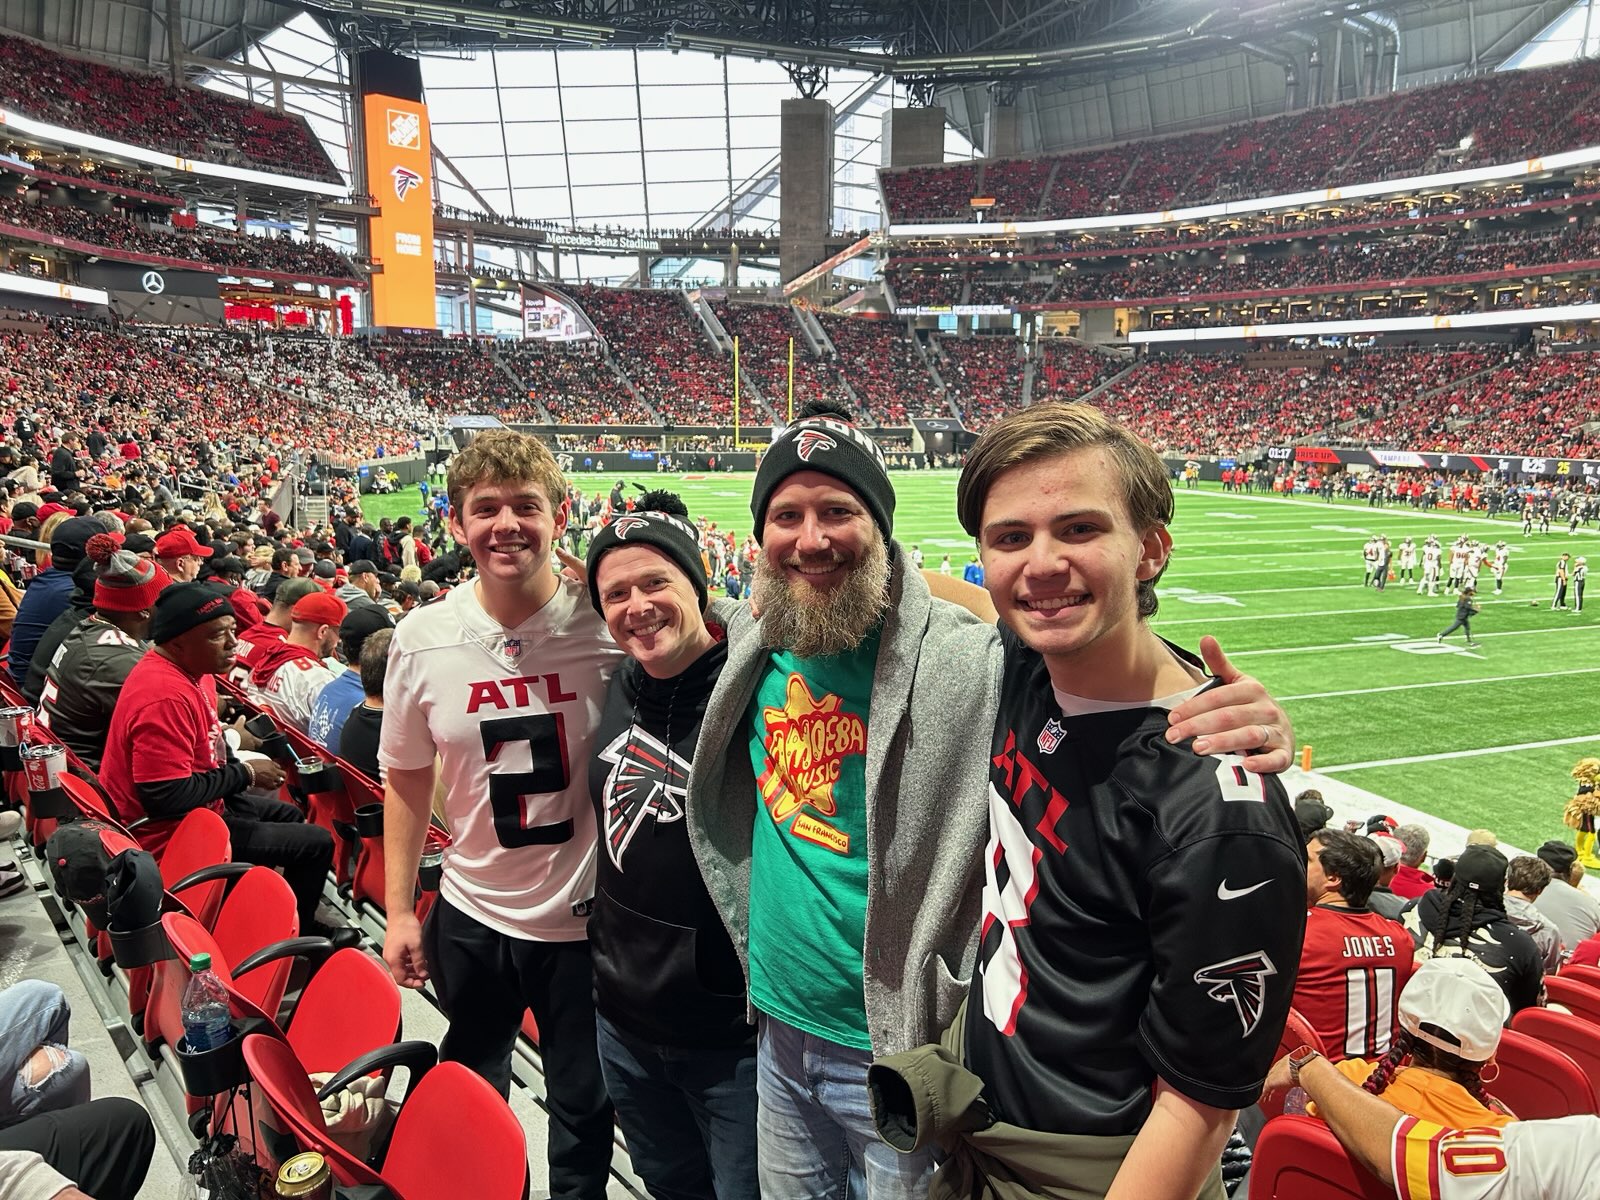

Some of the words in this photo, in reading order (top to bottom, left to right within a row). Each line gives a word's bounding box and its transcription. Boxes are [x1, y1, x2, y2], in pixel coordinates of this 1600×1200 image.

[545, 232, 618, 247] Mercedes-Benz
[620, 236, 659, 250] Stadium
[1268, 447, 1292, 459] 01:17
[1557, 461, 1571, 475] 25
[466, 673, 578, 714] ATL
[769, 715, 864, 771] AMOEBA
[479, 711, 575, 849] 2
[791, 758, 840, 792] MUSIC
[993, 728, 1070, 856] ATL
[797, 819, 812, 831] SAN
[812, 822, 848, 848] FRANCISCO
[1342, 935, 1396, 958] JONES
[1343, 966, 1397, 1057] 11
